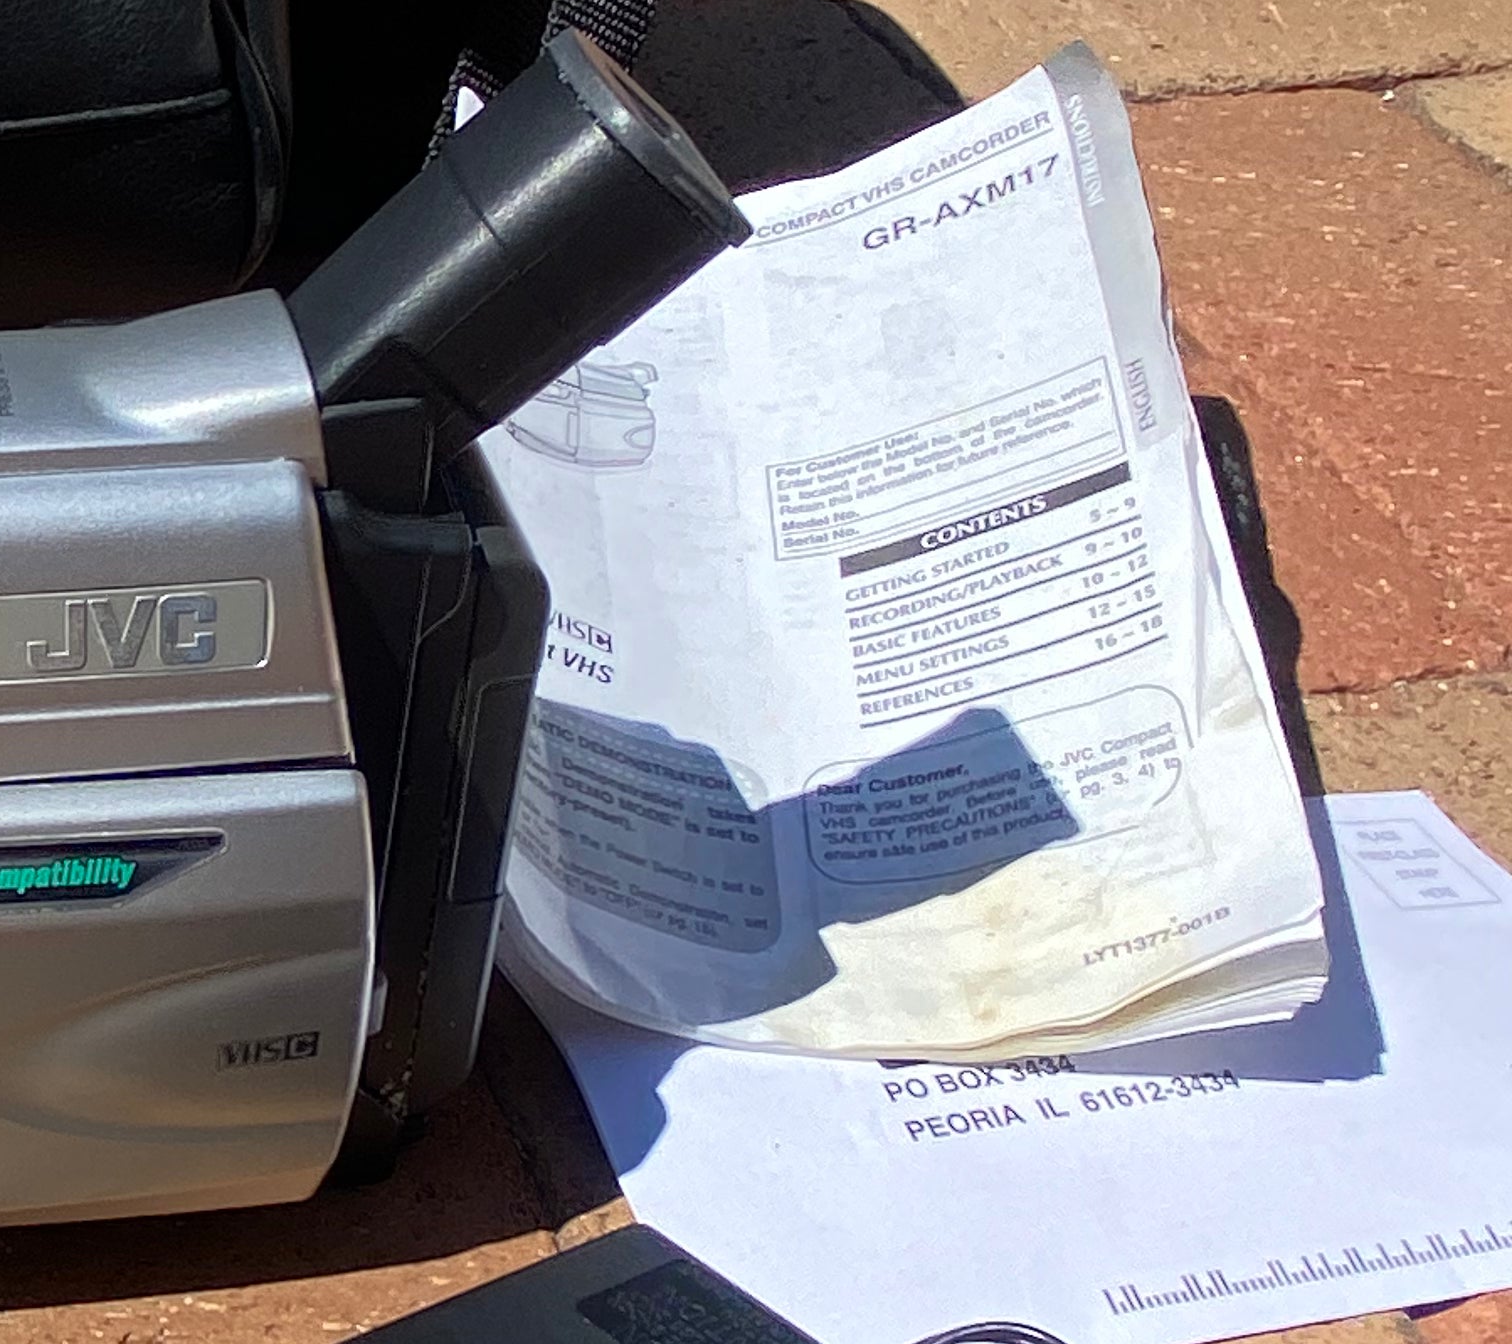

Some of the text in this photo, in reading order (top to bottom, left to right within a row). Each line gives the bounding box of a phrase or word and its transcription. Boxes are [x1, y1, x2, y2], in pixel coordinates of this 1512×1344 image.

[756, 110, 1051, 240] COMPACT VHS CAMCORDER
[862, 154, 1059, 251] GR-AXM17
[1125, 357, 1157, 432] ENGLISH
[782, 510, 860, 532] Model No.
[783, 527, 860, 548] Serial No.
[845, 569, 927, 603] GETTING
[931, 541, 1011, 578] STARTED
[1124, 496, 1137, 510] 9
[919, 494, 1048, 551] CONTENTS
[849, 554, 1064, 630] RECORDING/PLAYBACK
[1085, 543, 1098, 555] 9
[1121, 526, 1143, 543] 10
[852, 631, 906, 658] BASIC
[911, 606, 1002, 644] FEATURES
[1082, 572, 1105, 589] 10
[1128, 553, 1149, 569] 12
[26, 592, 217, 672] JVC
[563, 647, 615, 684] VHS
[856, 659, 915, 687] MENU
[919, 635, 1010, 671] SETTINGS
[1088, 602, 1111, 619] 12
[860, 677, 975, 716] REFERENCES
[1095, 633, 1118, 651] 16
[578, 735, 733, 792] DEMONSTRATION
[817, 782, 861, 797] Dear
[819, 800, 868, 815] Thank
[873, 798, 903, 814] you
[909, 793, 930, 806] for
[936, 767, 1021, 803] purchasing
[1059, 746, 1095, 768] JVC
[1100, 722, 1172, 755] Compact
[820, 815, 857, 830] VHS
[1075, 755, 1129, 784] please
[1138, 737, 1178, 760] read
[706, 825, 735, 842] set
[740, 829, 760, 844] to
[824, 848, 878, 861] ensure
[920, 837, 949, 853] use
[953, 831, 969, 846] of
[971, 825, 999, 841] this
[882, 1053, 1077, 1103] PO BOX 3434
[904, 1068, 1241, 1143] PEORIA IL 61612-3434
